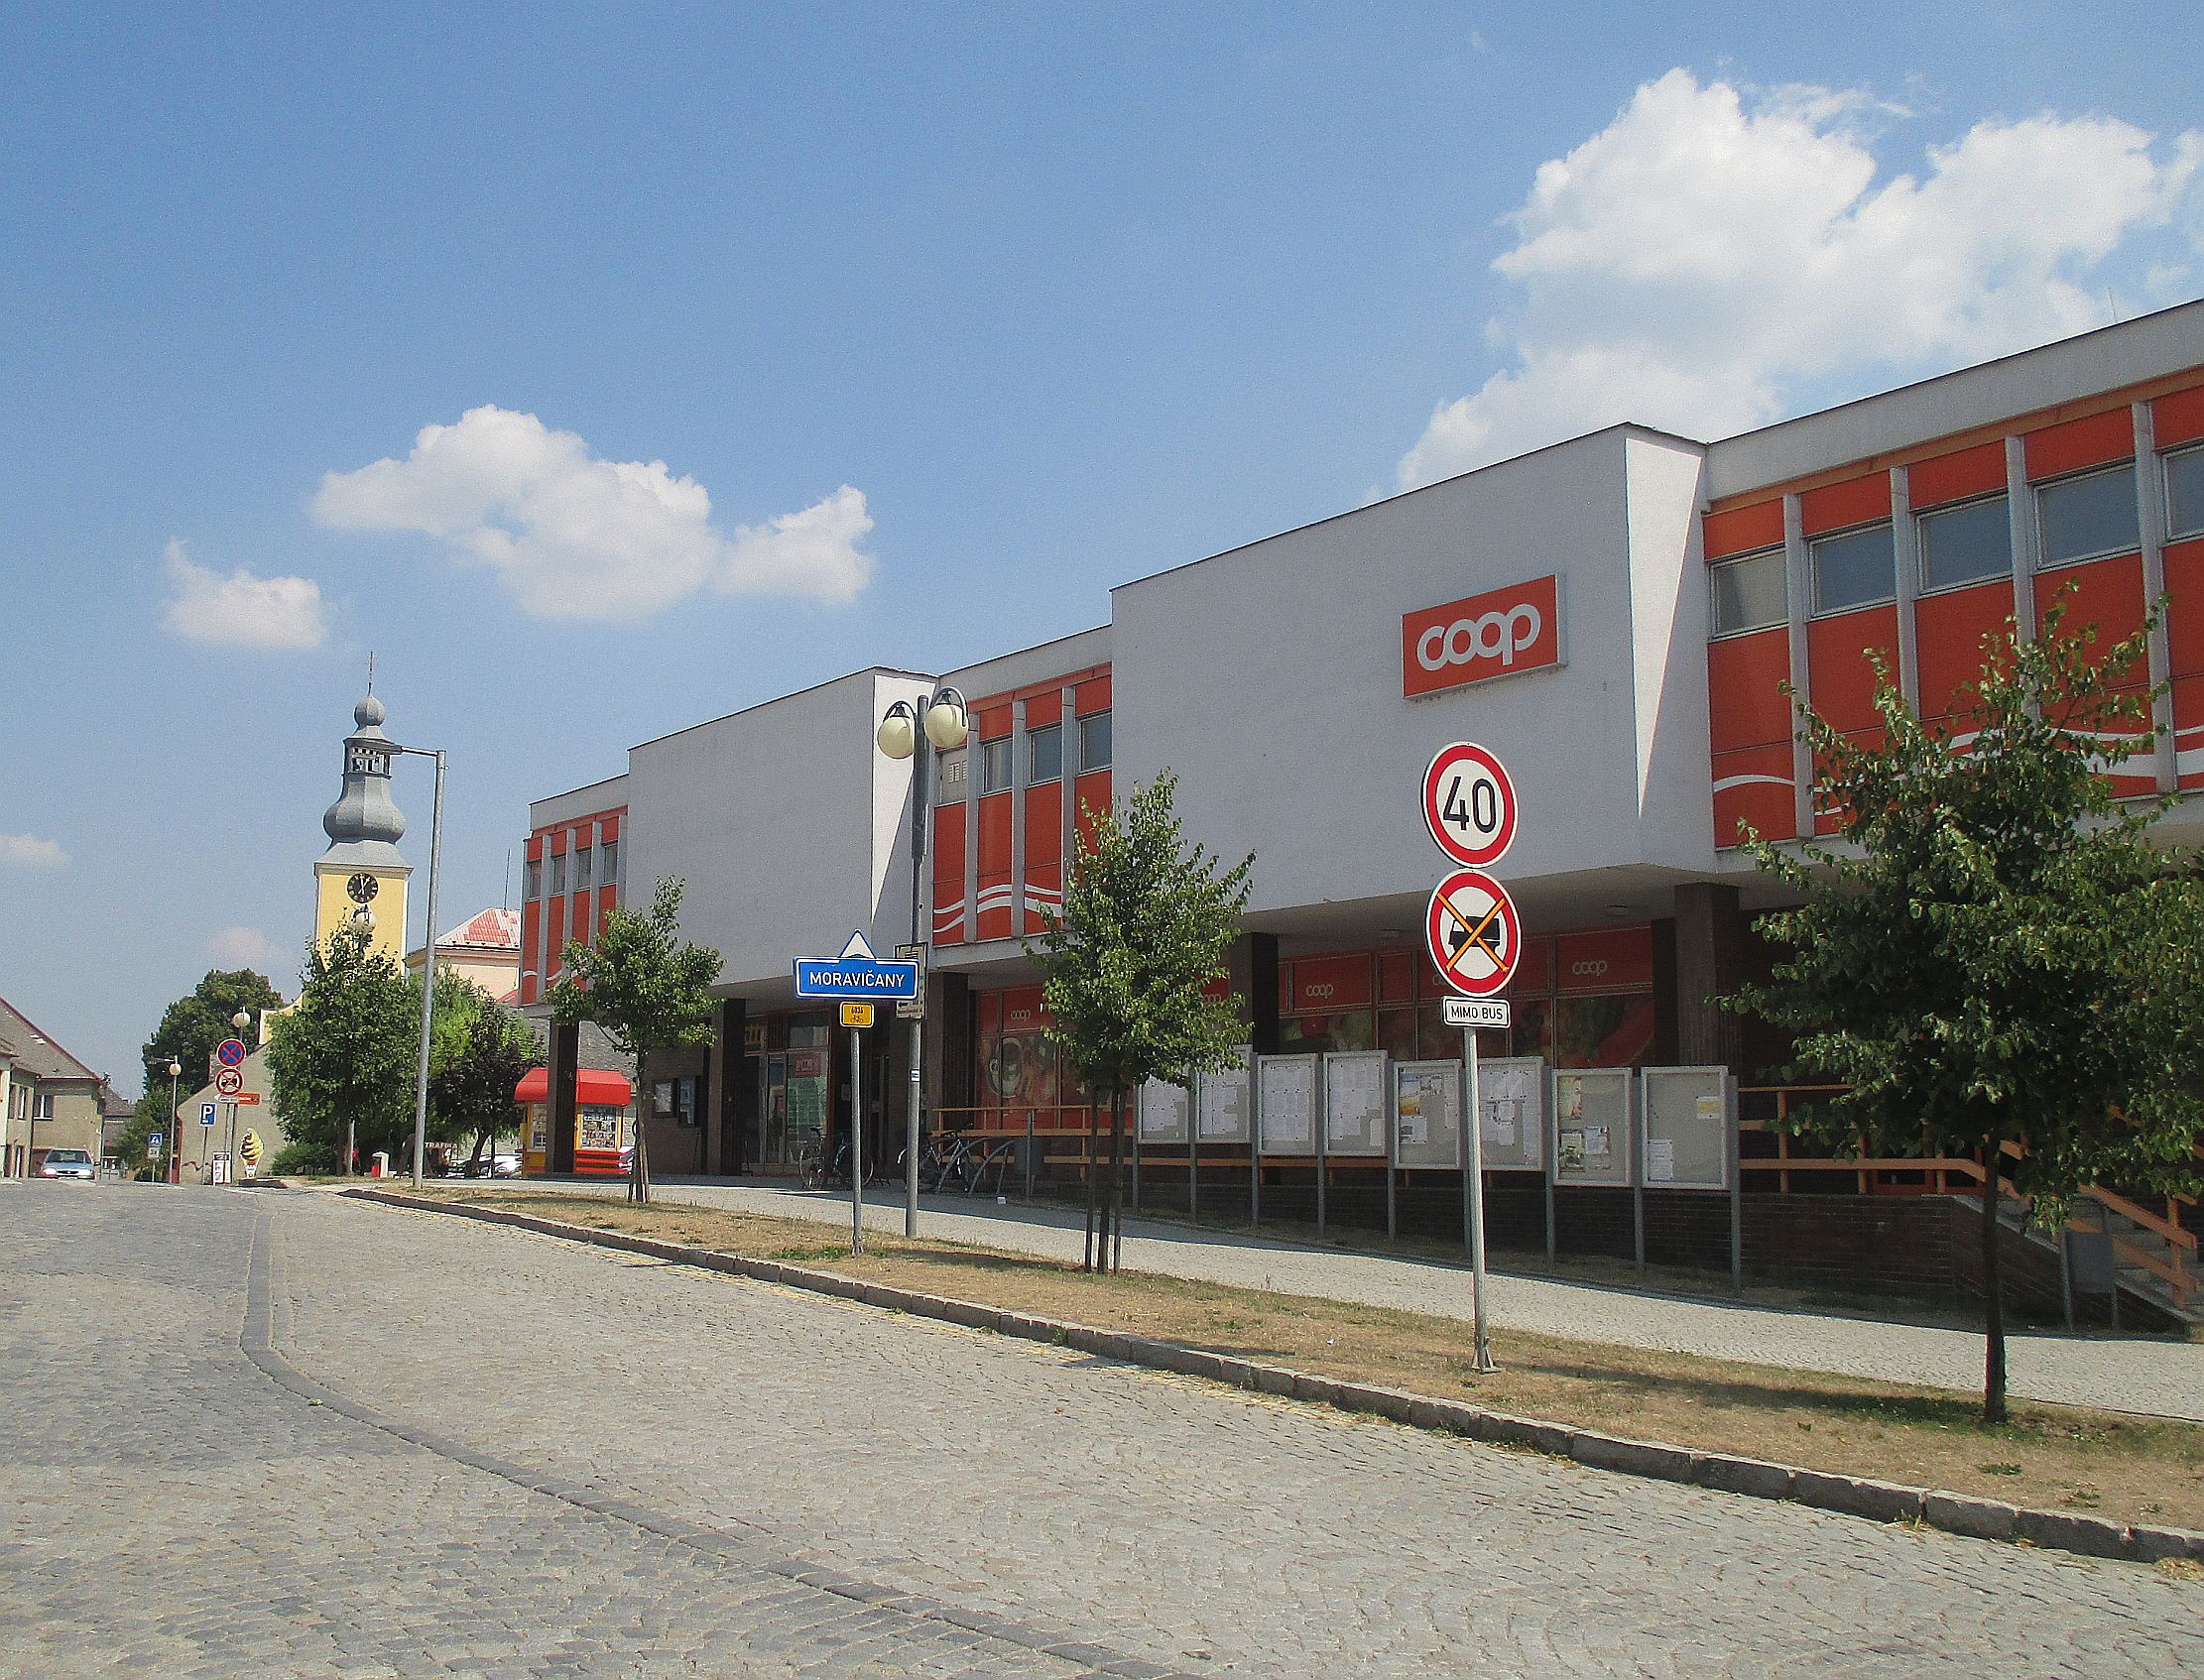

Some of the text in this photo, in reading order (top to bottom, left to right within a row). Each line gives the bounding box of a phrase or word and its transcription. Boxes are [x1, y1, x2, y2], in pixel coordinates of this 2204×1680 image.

[1416, 603, 1541, 671] coop
[1442, 776, 1497, 834] 40
[1571, 960, 1608, 976] coop
[808, 969, 906, 988] MORAVIČANY
[1305, 984, 1334, 999] coop
[1010, 1009, 1032, 1022] coop
[1451, 1006, 1503, 1020] MIMO BUS
[202, 1105, 214, 1120] P
